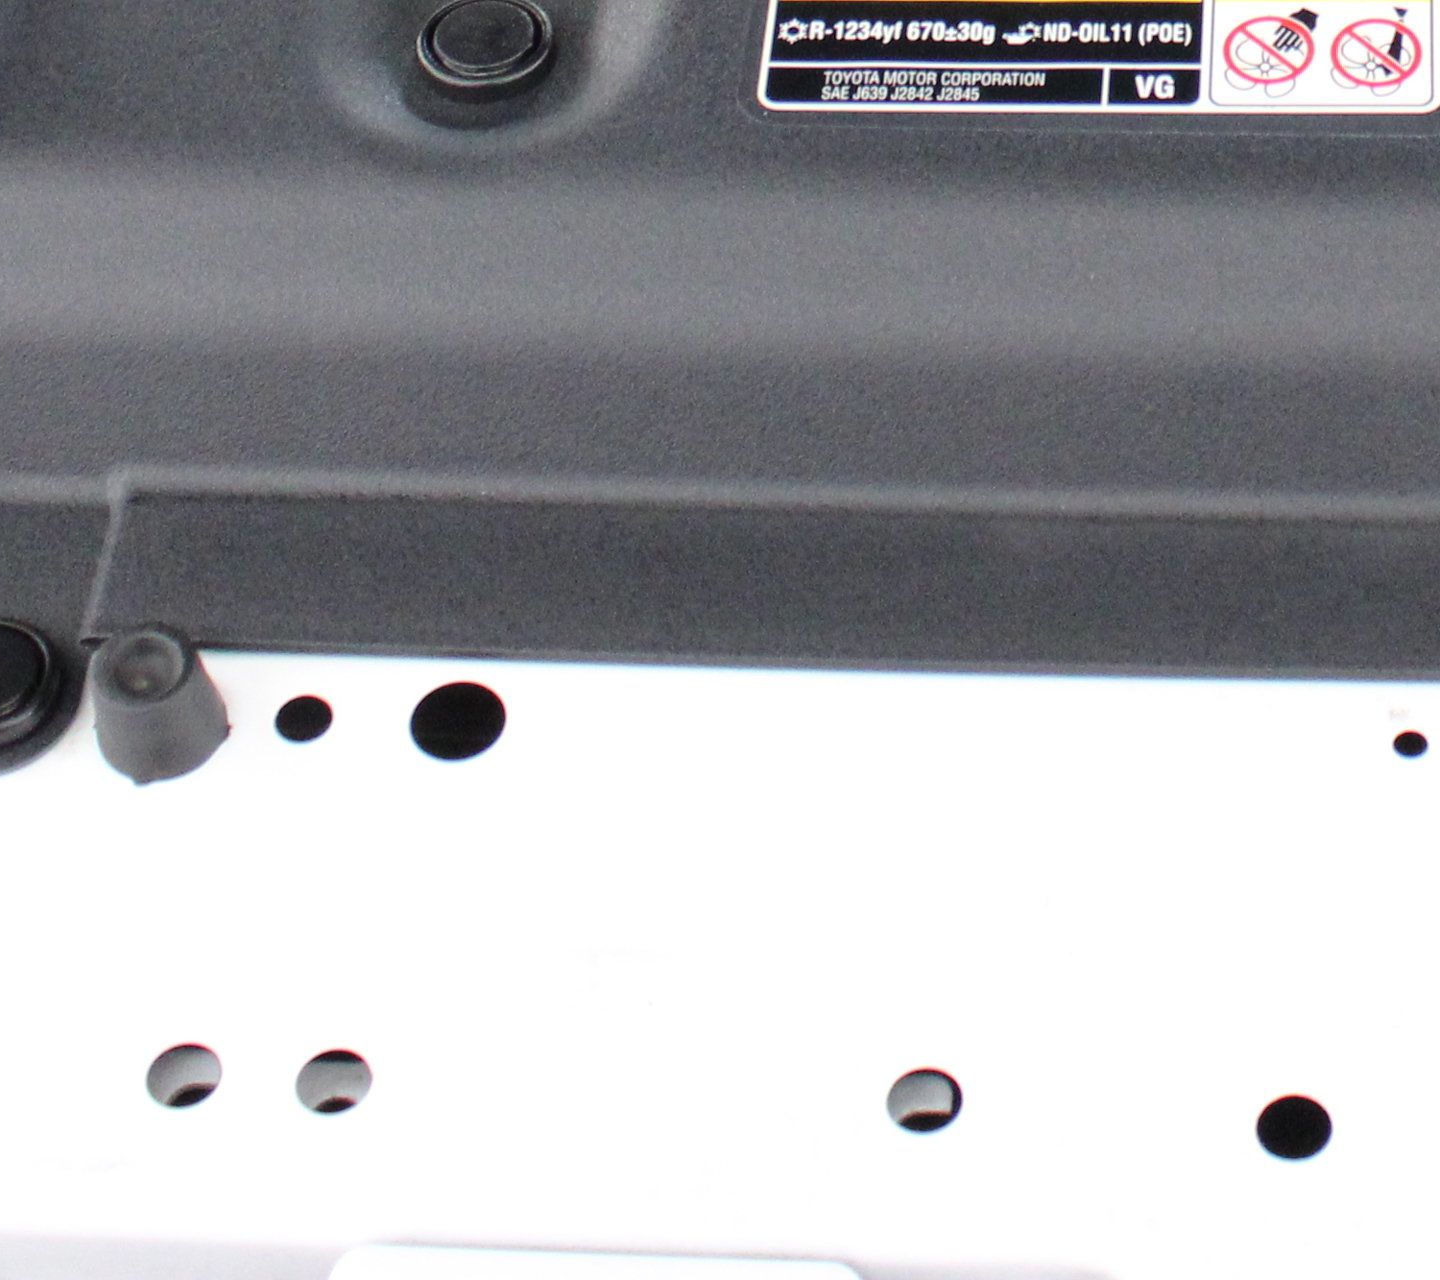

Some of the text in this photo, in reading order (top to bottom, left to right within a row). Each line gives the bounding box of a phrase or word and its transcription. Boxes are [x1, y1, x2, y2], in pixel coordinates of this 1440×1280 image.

[808, 19, 1194, 47] R-1234yf 670±30g ND-OIL11 (POE)
[820, 85, 981, 102] SAE J639 J2842 J2845
[822, 69, 1176, 100] TOYOTA MOTOR CORPORATION VG
